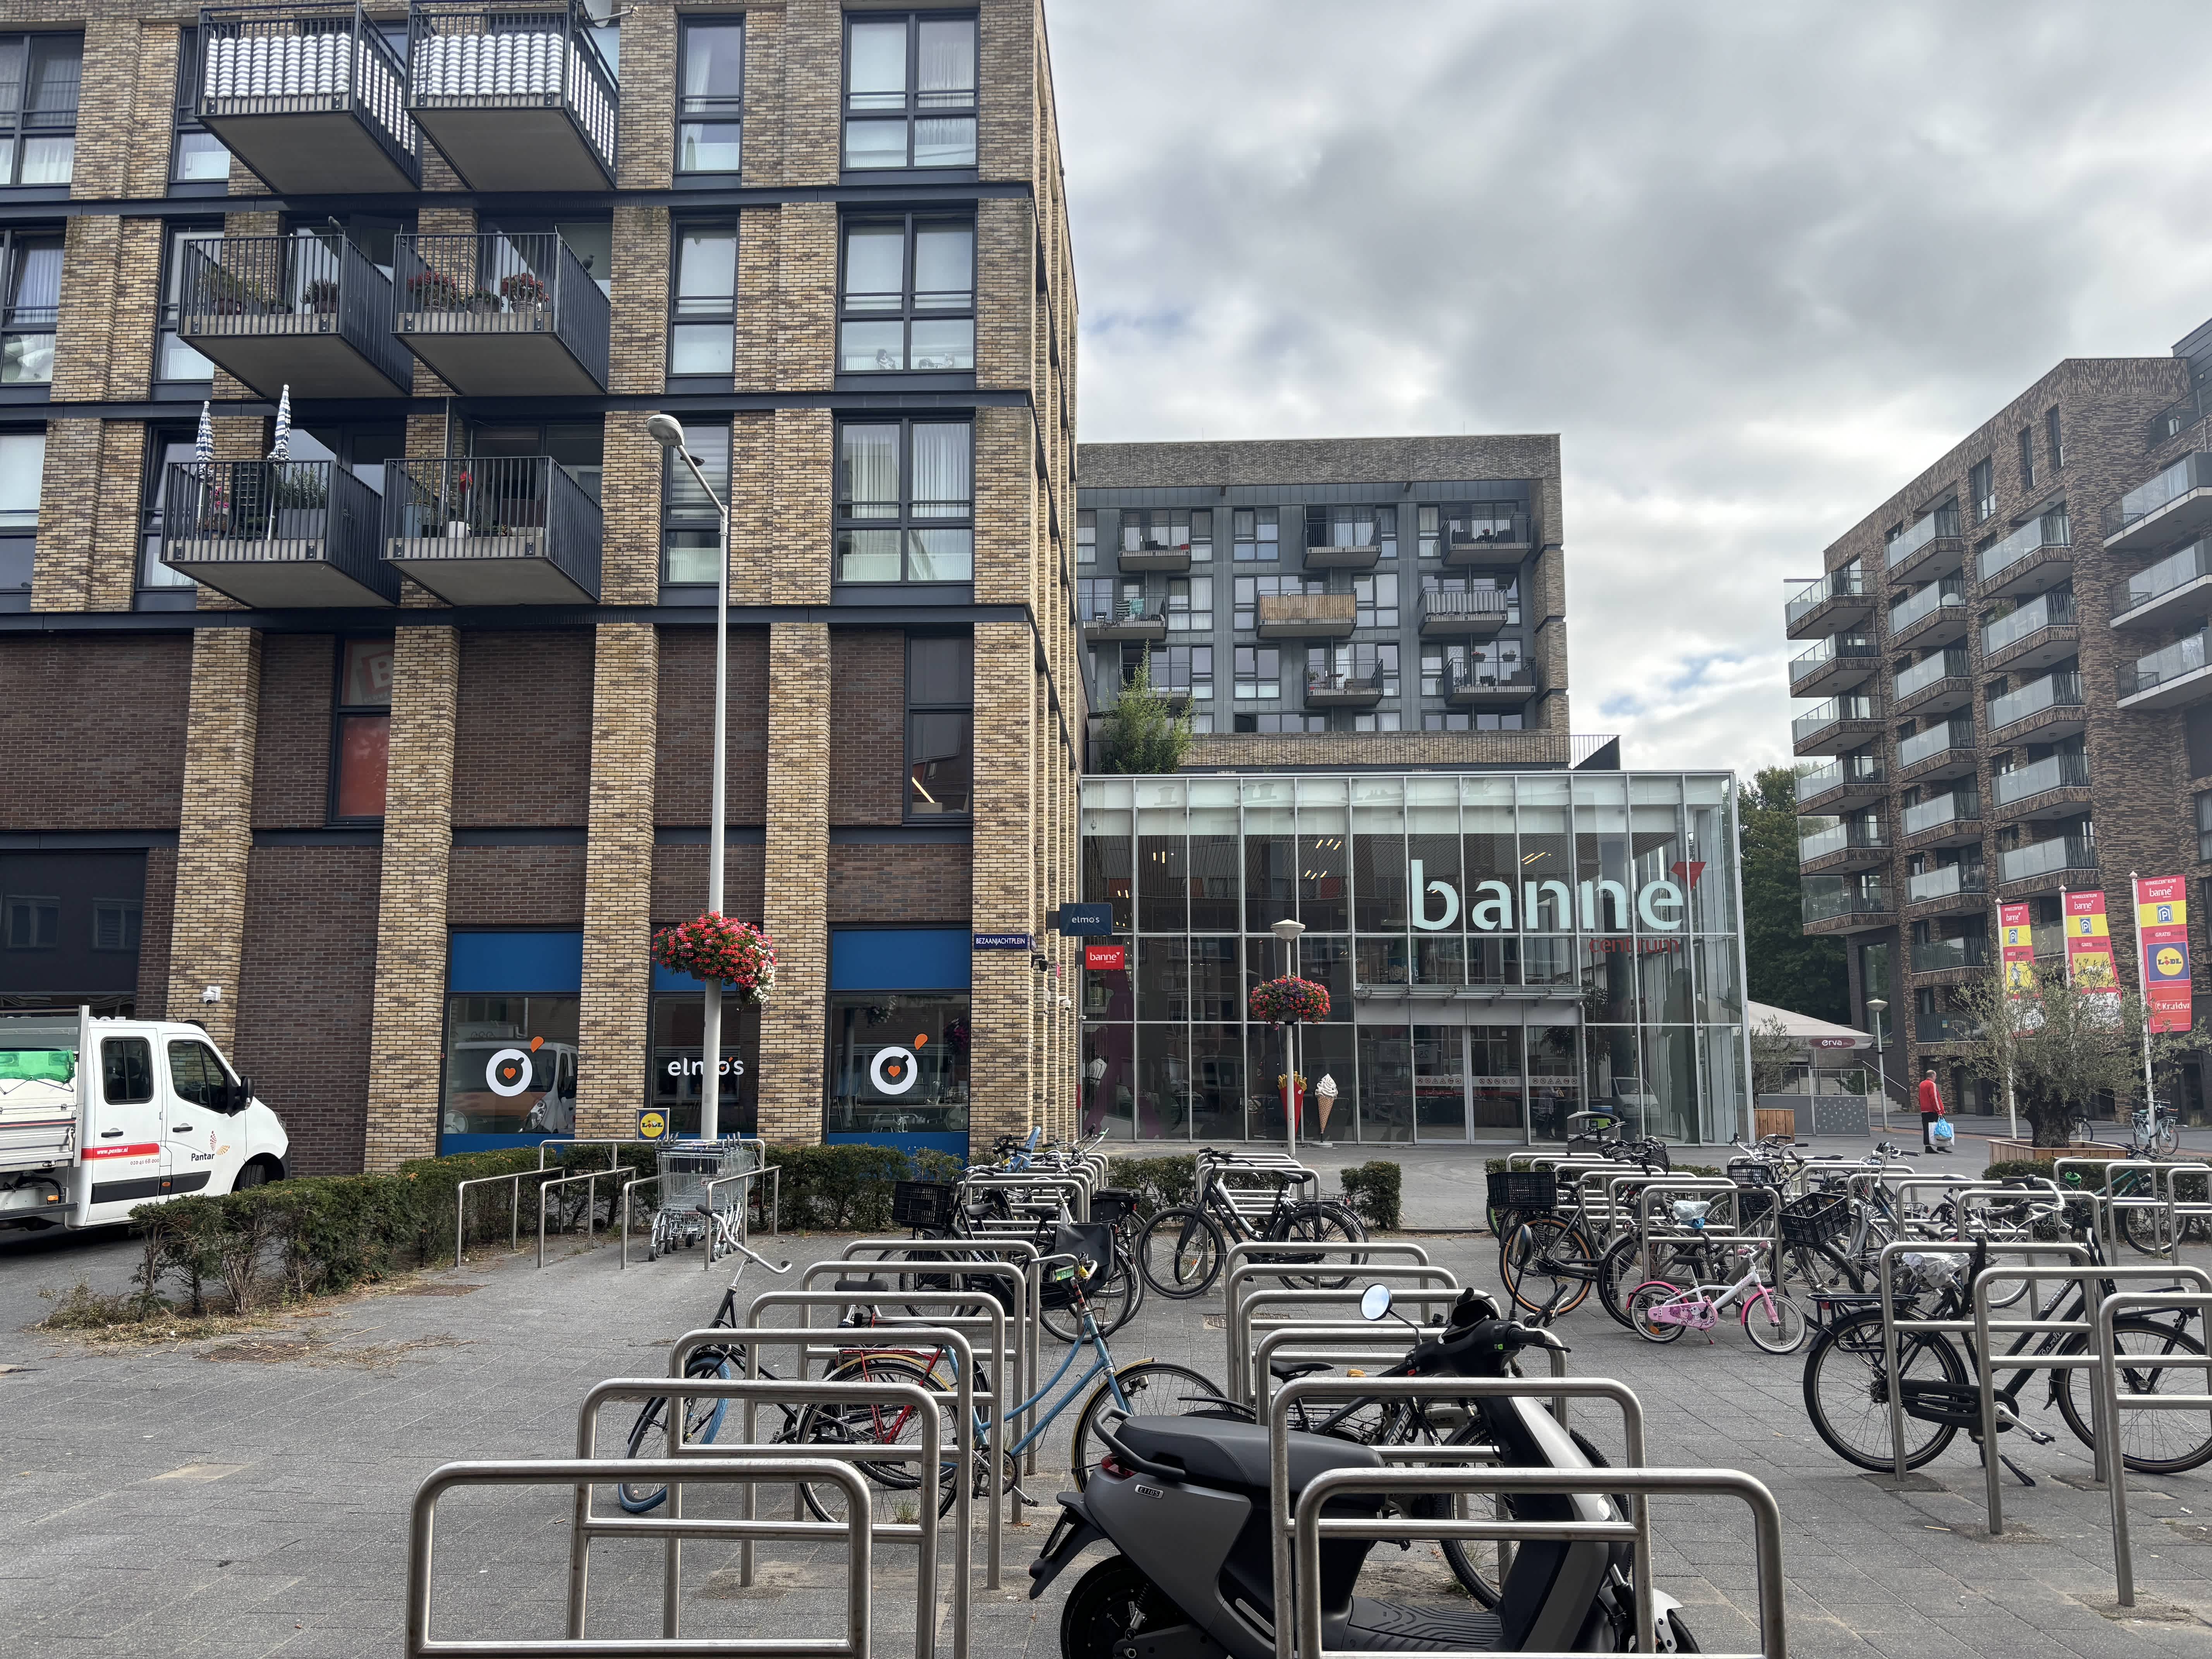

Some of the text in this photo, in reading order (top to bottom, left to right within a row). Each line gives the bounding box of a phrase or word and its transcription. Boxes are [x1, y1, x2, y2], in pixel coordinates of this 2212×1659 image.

[1411, 859, 1684, 930] banne
[2150, 888, 2172, 897] banne
[2074, 902, 2092, 910] banne
[975, 938, 1025, 946] BEZAANJACHTPLEIN
[1589, 937, 1679, 953] centrum
[1090, 952, 1117, 961] banne
[2157, 956, 2182, 965] LIDL
[97, 1147, 129, 1155] www.pantar.nl
[191, 1153, 215, 1161] Pantar
[2038, 1332, 2063, 1355] Gazell
